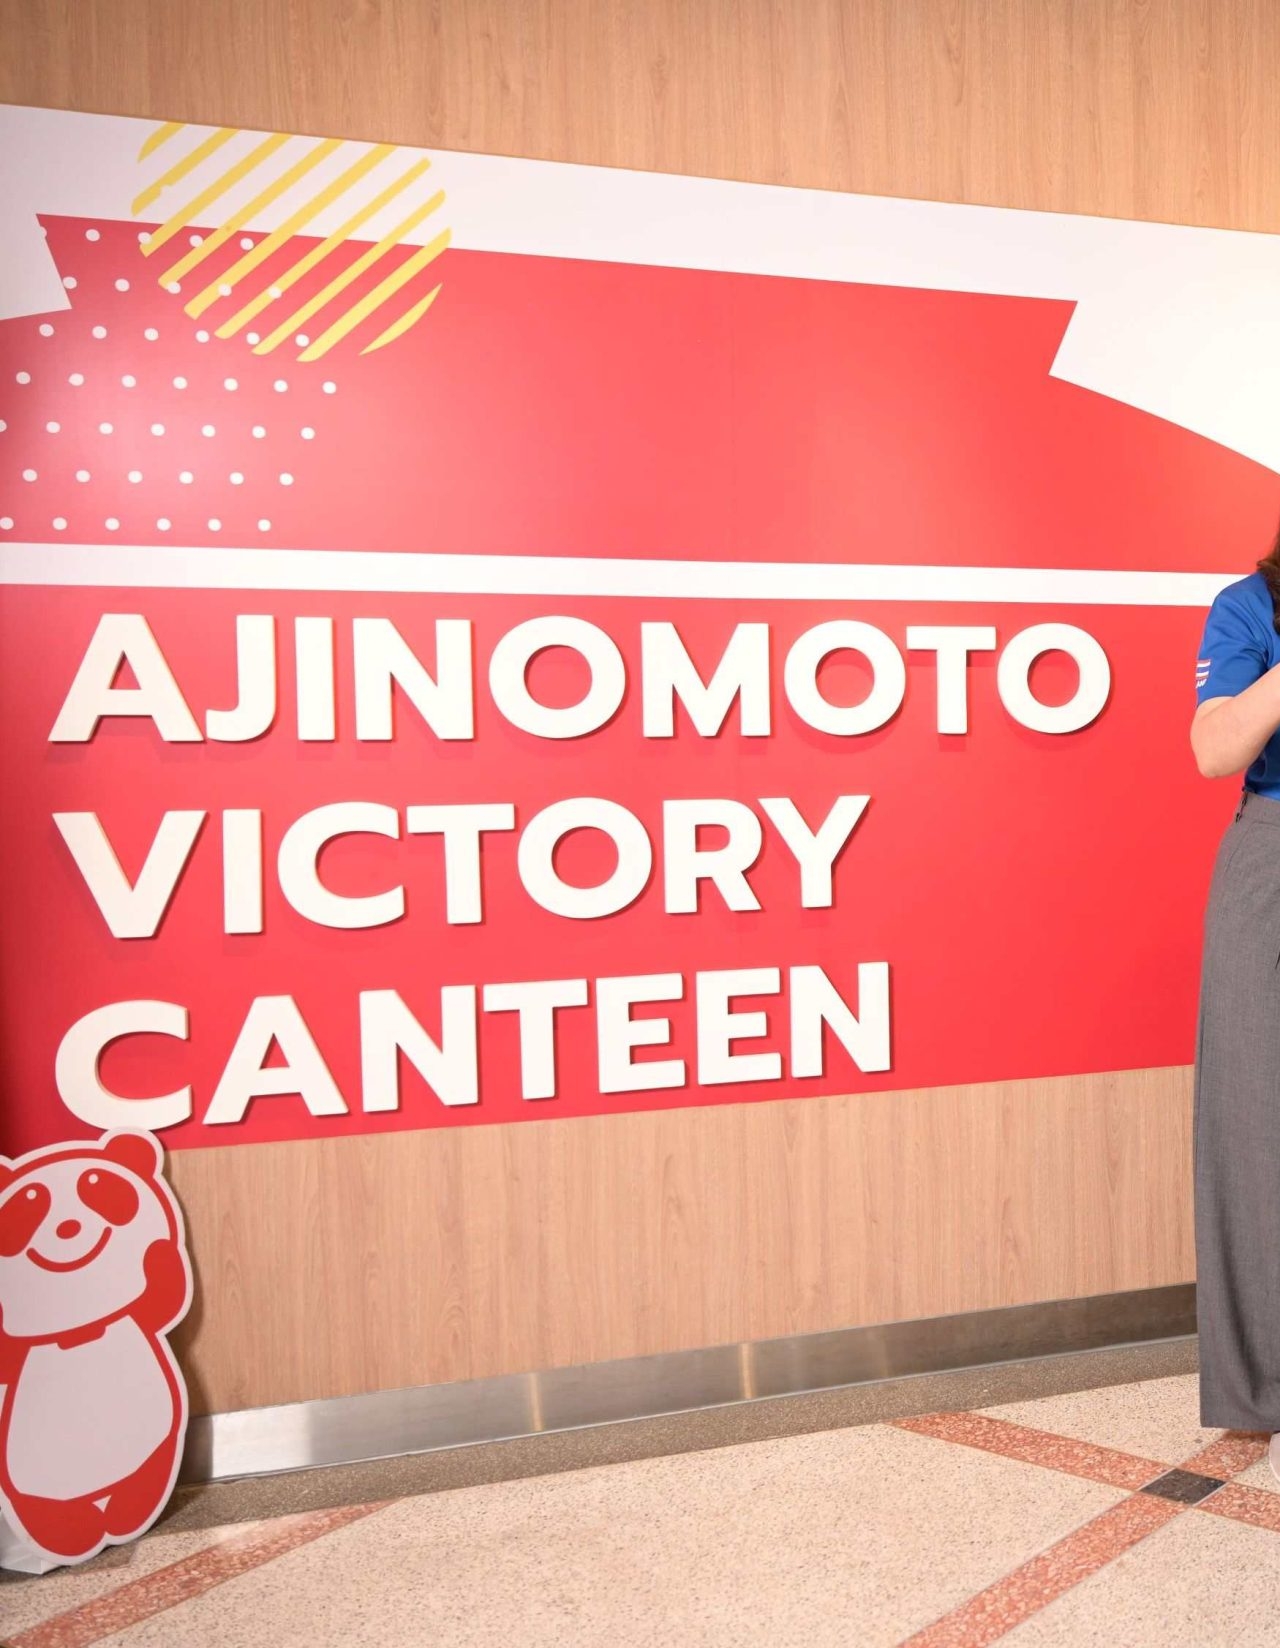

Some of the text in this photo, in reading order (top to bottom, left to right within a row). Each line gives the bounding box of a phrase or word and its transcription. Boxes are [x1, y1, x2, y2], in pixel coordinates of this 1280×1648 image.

[48, 613, 1111, 743] AJINOMOTO
[52, 795, 871, 940] VICTORY
[55, 961, 891, 1132] CANTEEN
